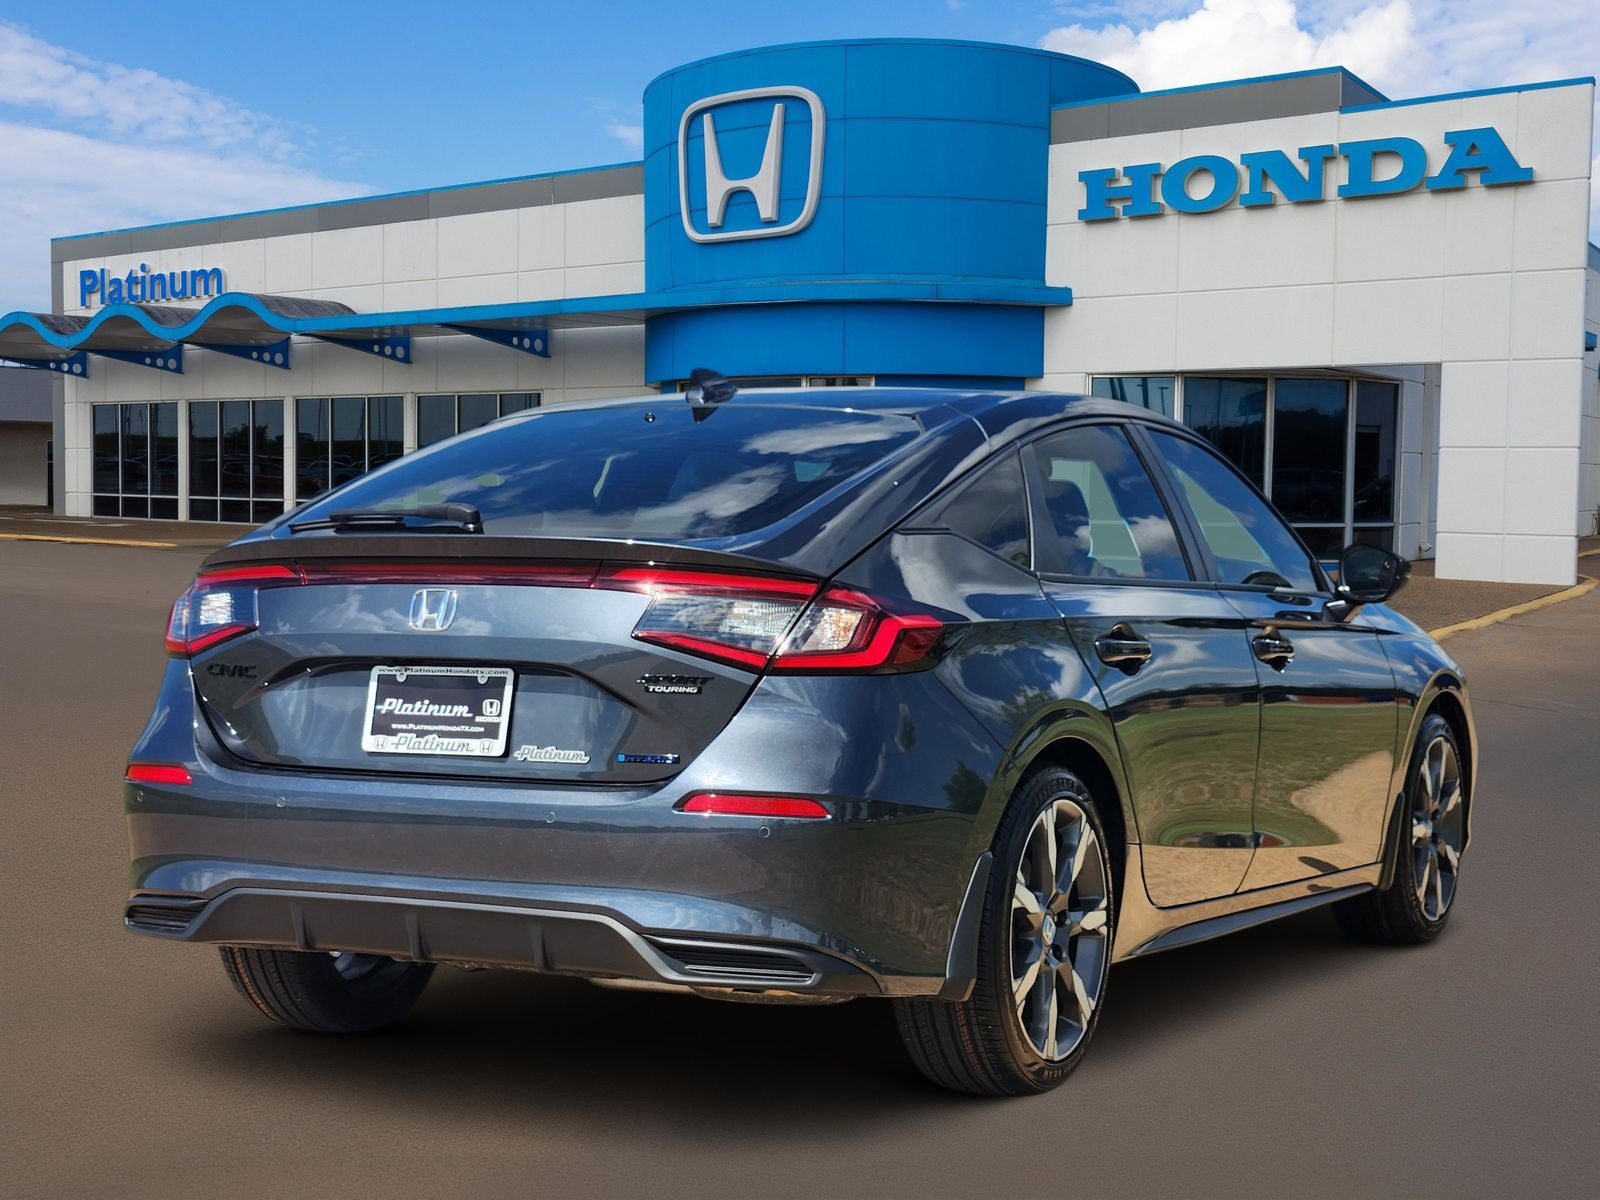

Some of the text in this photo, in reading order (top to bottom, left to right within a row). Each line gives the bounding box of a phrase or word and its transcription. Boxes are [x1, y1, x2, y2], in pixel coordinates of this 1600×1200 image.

[1078, 127, 1534, 222] HONDA
[80, 262, 224, 307] Platinum
[207, 663, 257, 679] CIVIC
[648, 685, 698, 694] TOURING
[376, 698, 473, 717] Platinum
[391, 734, 475, 753] Platinum
[514, 745, 590, 764] Platinum
